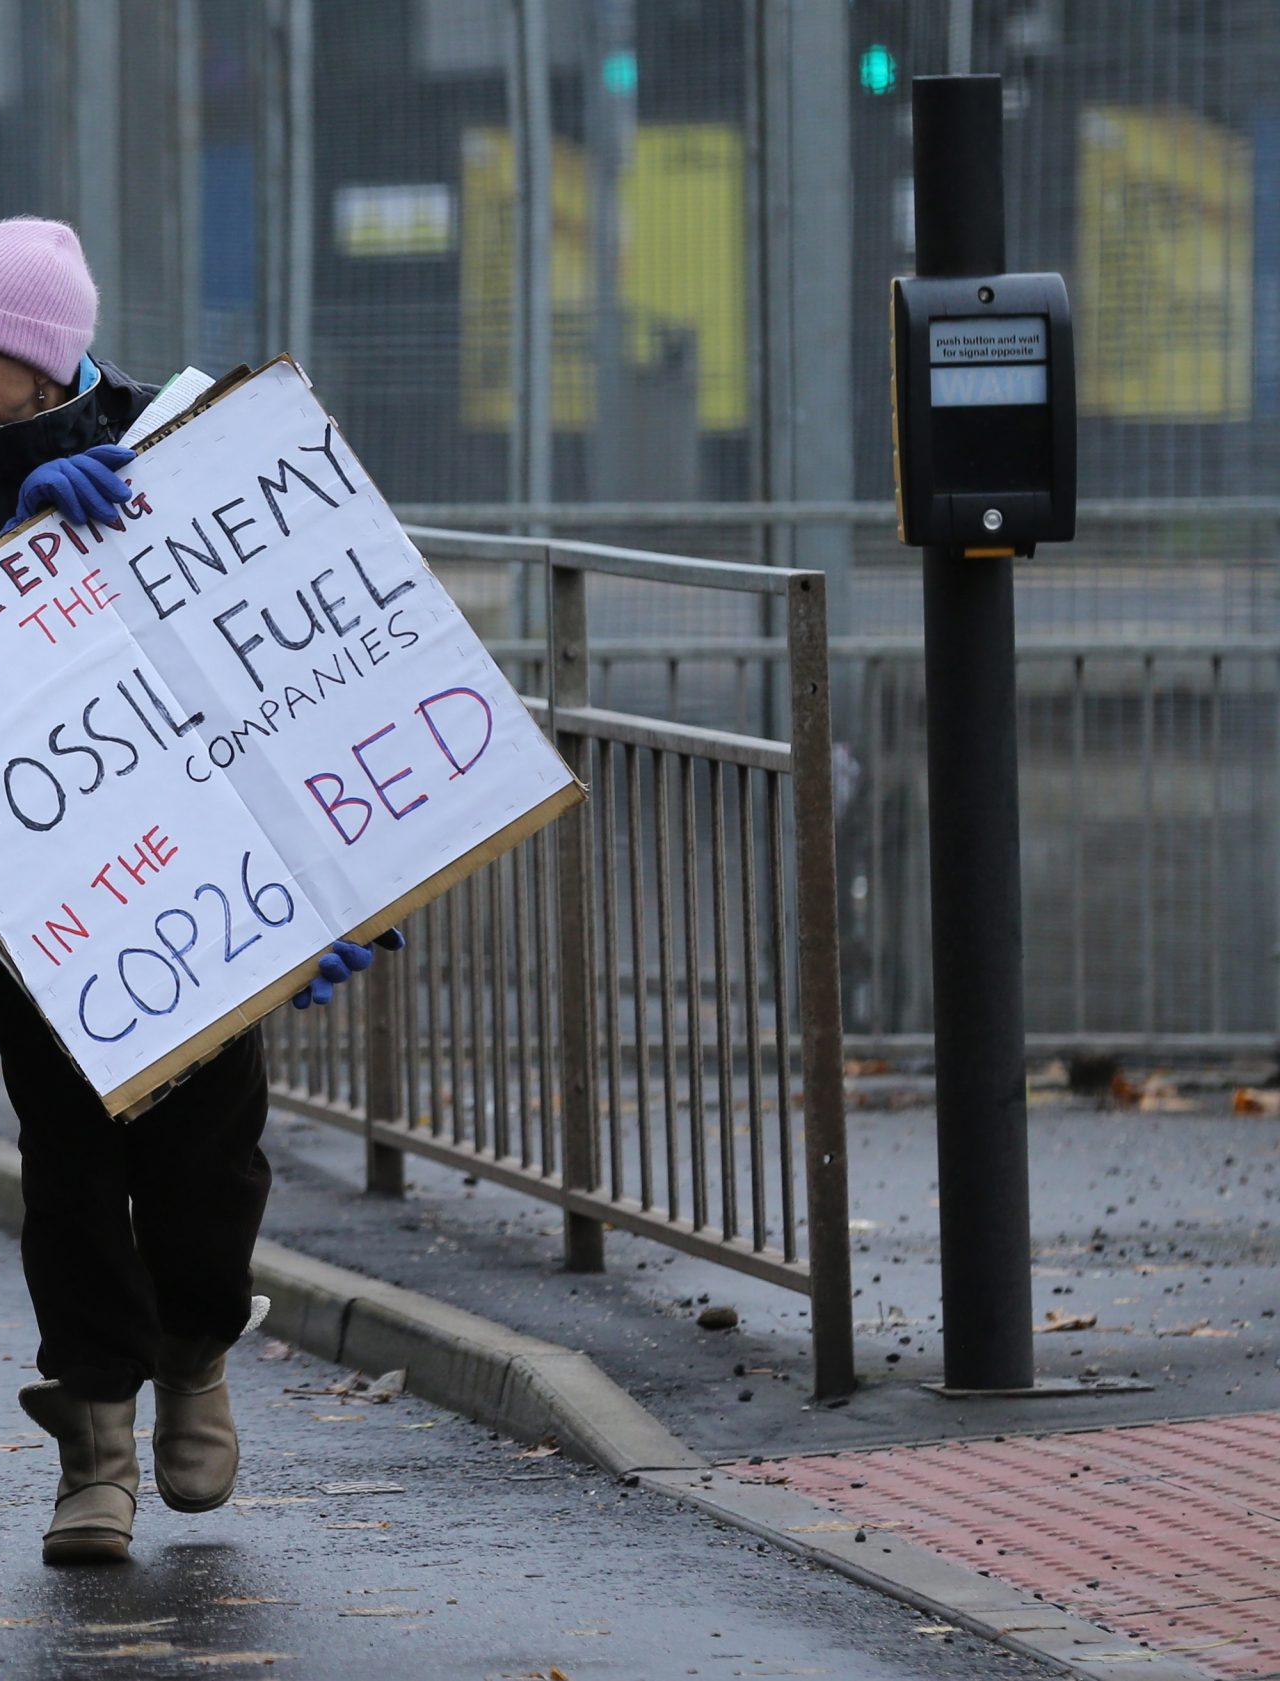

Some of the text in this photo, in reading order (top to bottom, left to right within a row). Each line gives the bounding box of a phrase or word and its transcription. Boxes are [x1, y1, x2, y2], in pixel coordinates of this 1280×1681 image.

[936, 334, 1040, 347] push button and wait
[943, 346, 1034, 358] for signal opposite
[19, 569, 121, 644] THE
[129, 423, 357, 620] ENEMY
[213, 548, 417, 692] FUEL
[186, 611, 419, 782] COMPANIES
[32, 825, 178, 966] IN THE
[79, 687, 492, 1042] COP26 BED
